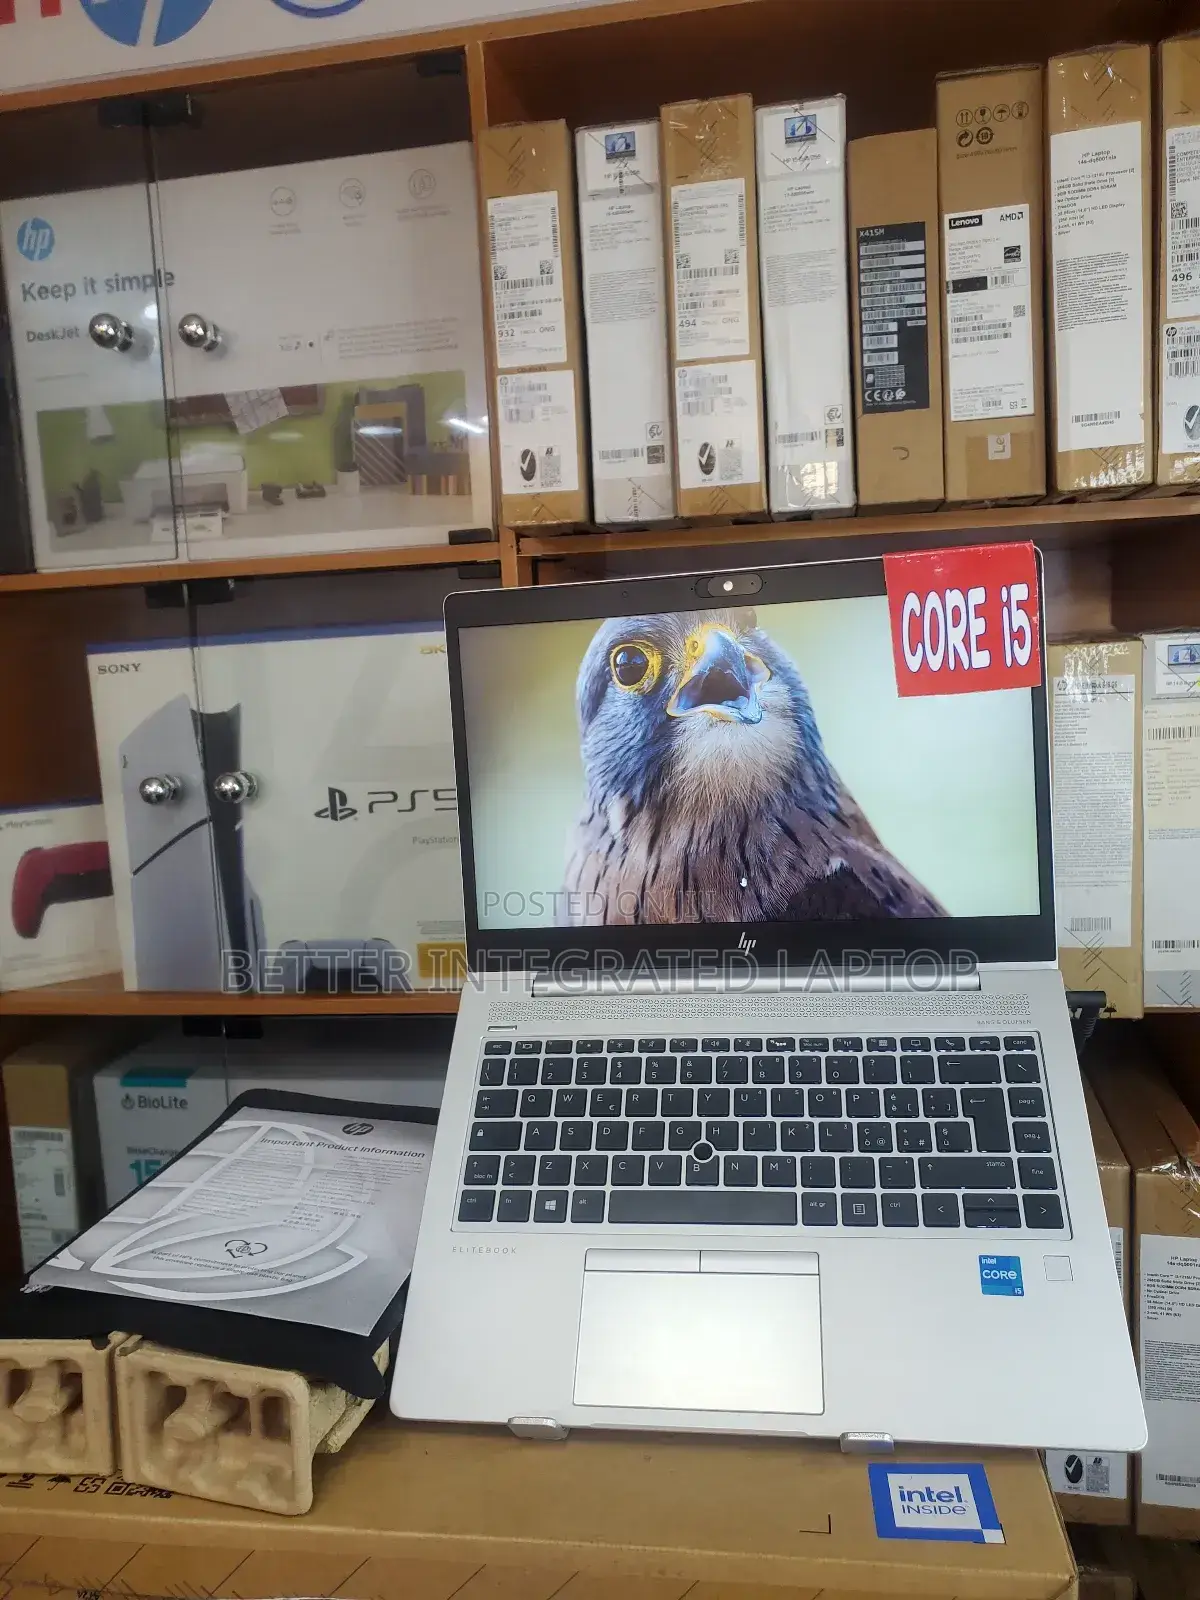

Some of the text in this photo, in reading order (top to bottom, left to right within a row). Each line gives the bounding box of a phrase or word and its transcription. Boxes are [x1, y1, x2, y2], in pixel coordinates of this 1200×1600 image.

[1000, 213, 1017, 222] AMD
[951, 217, 980, 227] Lenovo
[22, 218, 51, 260] hp
[1172, 272, 1193, 282] 496
[20, 268, 175, 302] Keep it simple
[678, 319, 697, 328] 494
[26, 326, 80, 343] DeskJet
[497, 328, 515, 337] 932
[900, 581, 1033, 673] CORE i5
[97, 662, 142, 675] SONY
[367, 789, 457, 814] PS5
[686, 1071, 693, 1079] 6
[795, 1071, 802, 1079] 9
[527, 1094, 536, 1102] Q
[563, 1094, 573, 1102] W
[741, 1094, 748, 1102] U
[816, 1094, 824, 1102] O
[137, 1095, 189, 1110] BioLite
[567, 1127, 574, 1135] S
[603, 1127, 611, 1135] D
[639, 1127, 645, 1135] F
[676, 1127, 684, 1135] G
[712, 1127, 720, 1135] H
[750, 1127, 756, 1136] J
[788, 1128, 795, 1136] K
[877, 1138, 885, 1146] @
[260, 1137, 426, 1159] Important Product Information
[546, 1162, 552, 1170] Z
[582, 1162, 589, 1170] X
[618, 1162, 627, 1170] C
[656, 1162, 663, 1170] V
[731, 1162, 739, 1170] N
[770, 1163, 778, 1171] M
[452, 1246, 517, 1254] ELITEBOOK
[981, 1257, 997, 1265] intel
[898, 1485, 964, 1504] intel
